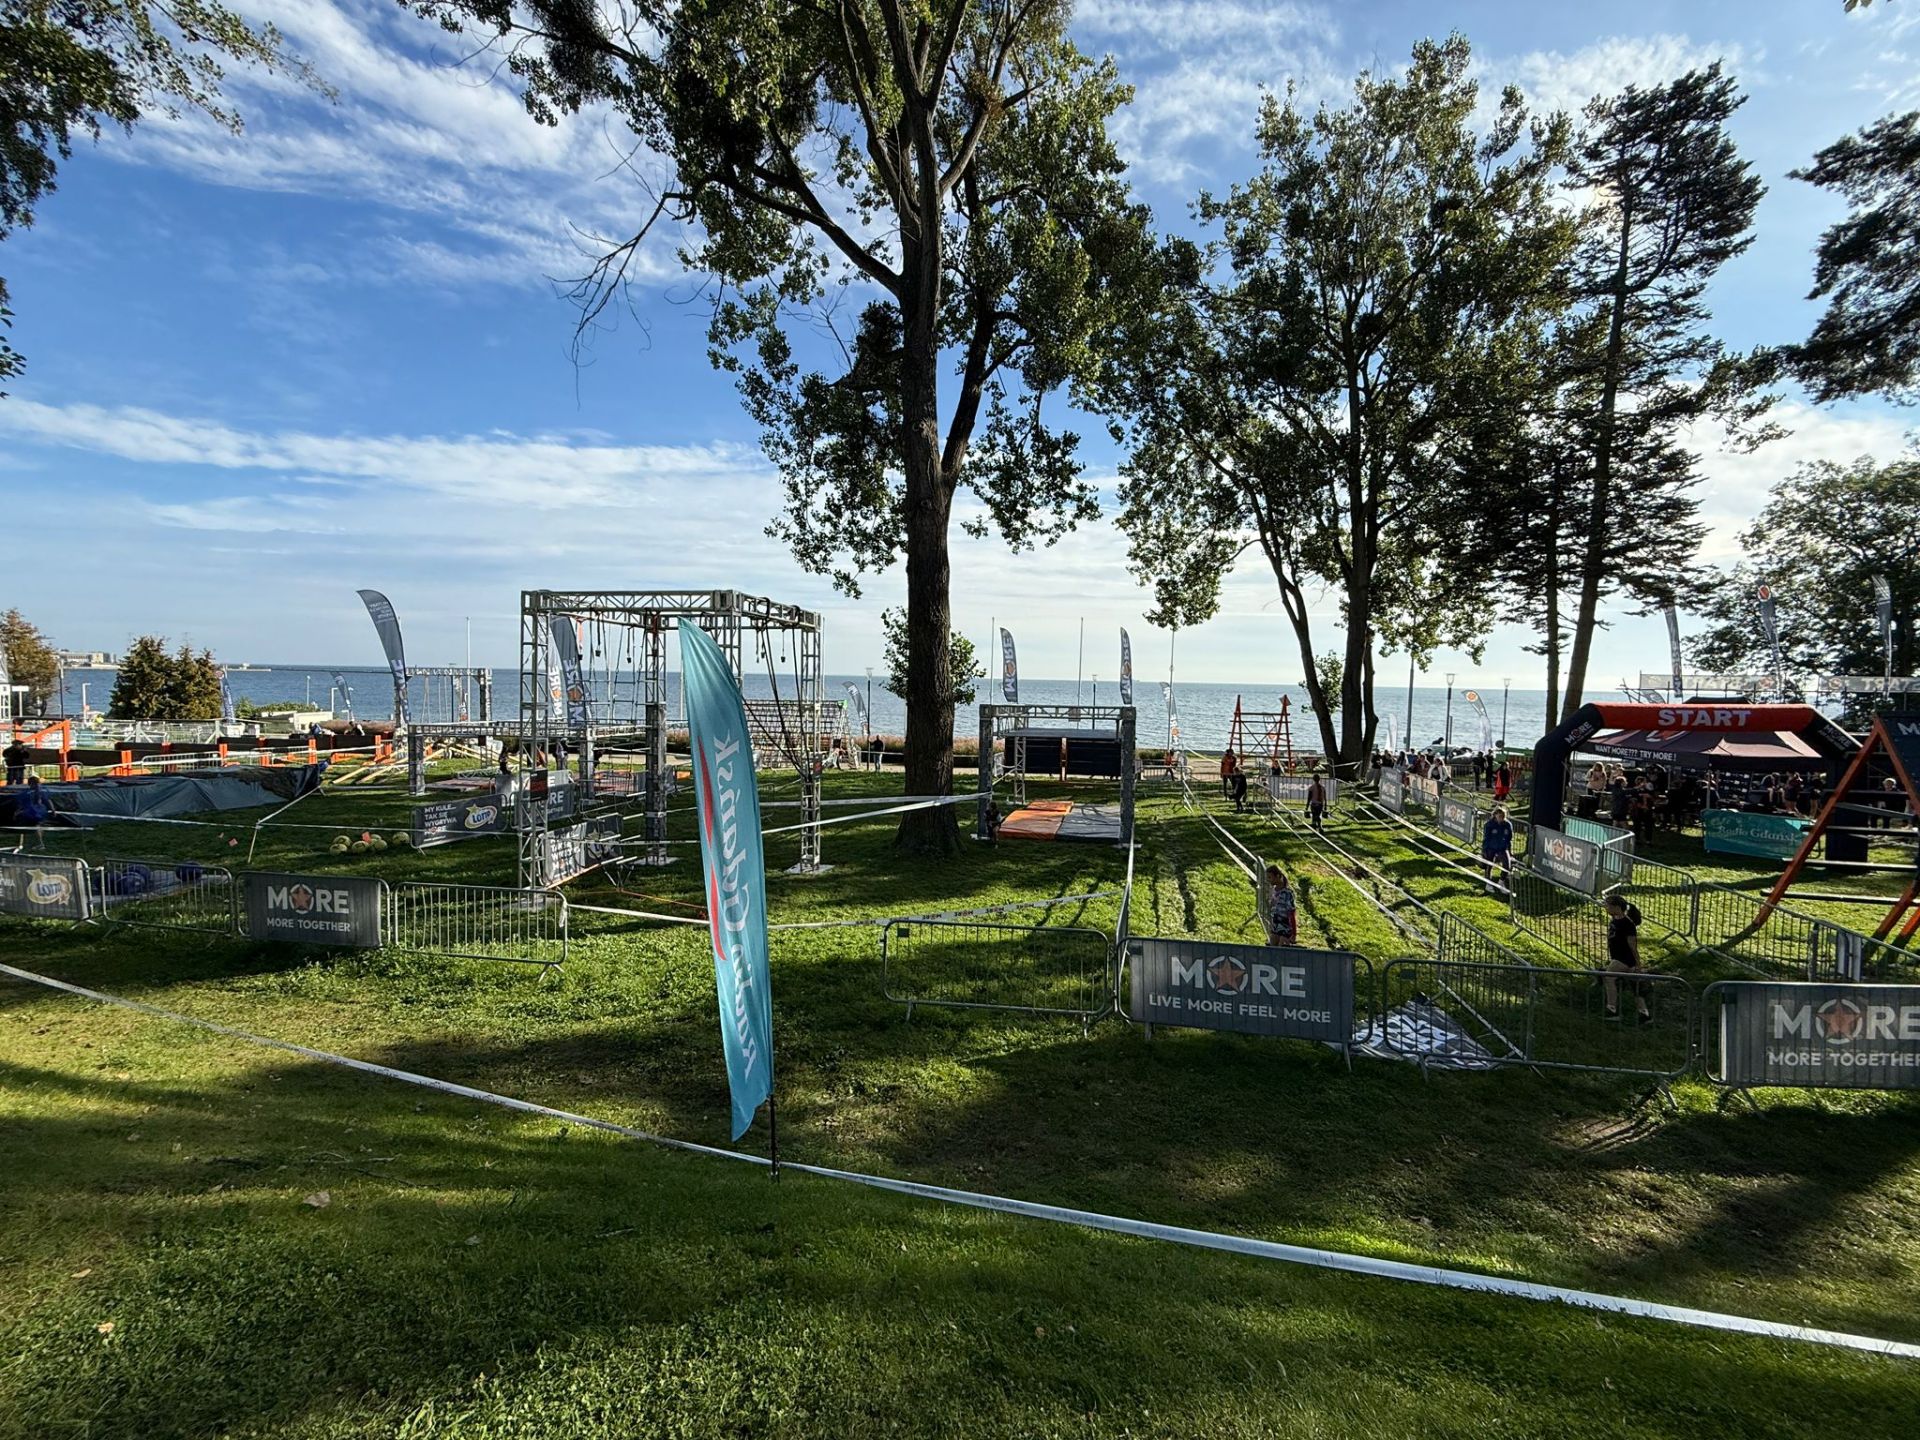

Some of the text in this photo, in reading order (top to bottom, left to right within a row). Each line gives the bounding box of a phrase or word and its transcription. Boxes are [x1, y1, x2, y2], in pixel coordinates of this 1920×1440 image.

[1658, 708, 1752, 727] START
[1564, 721, 1593, 744] MORE
[1595, 744, 1611, 753] WANT
[1611, 746, 1638, 757] MORE???
[1640, 750, 1652, 759] TRY
[1652, 752, 1673, 761] MORE
[1544, 837, 1582, 866] MORE
[267, 884, 350, 915] MORE
[266, 917, 352, 933] MORE TOGETHER
[1171, 955, 1306, 999] MORE
[1149, 994, 1332, 1024] LIVE MORE FEEL MORE
[1773, 998, 1920, 1045] MORE
[1768, 1052, 1822, 1067] MORE
